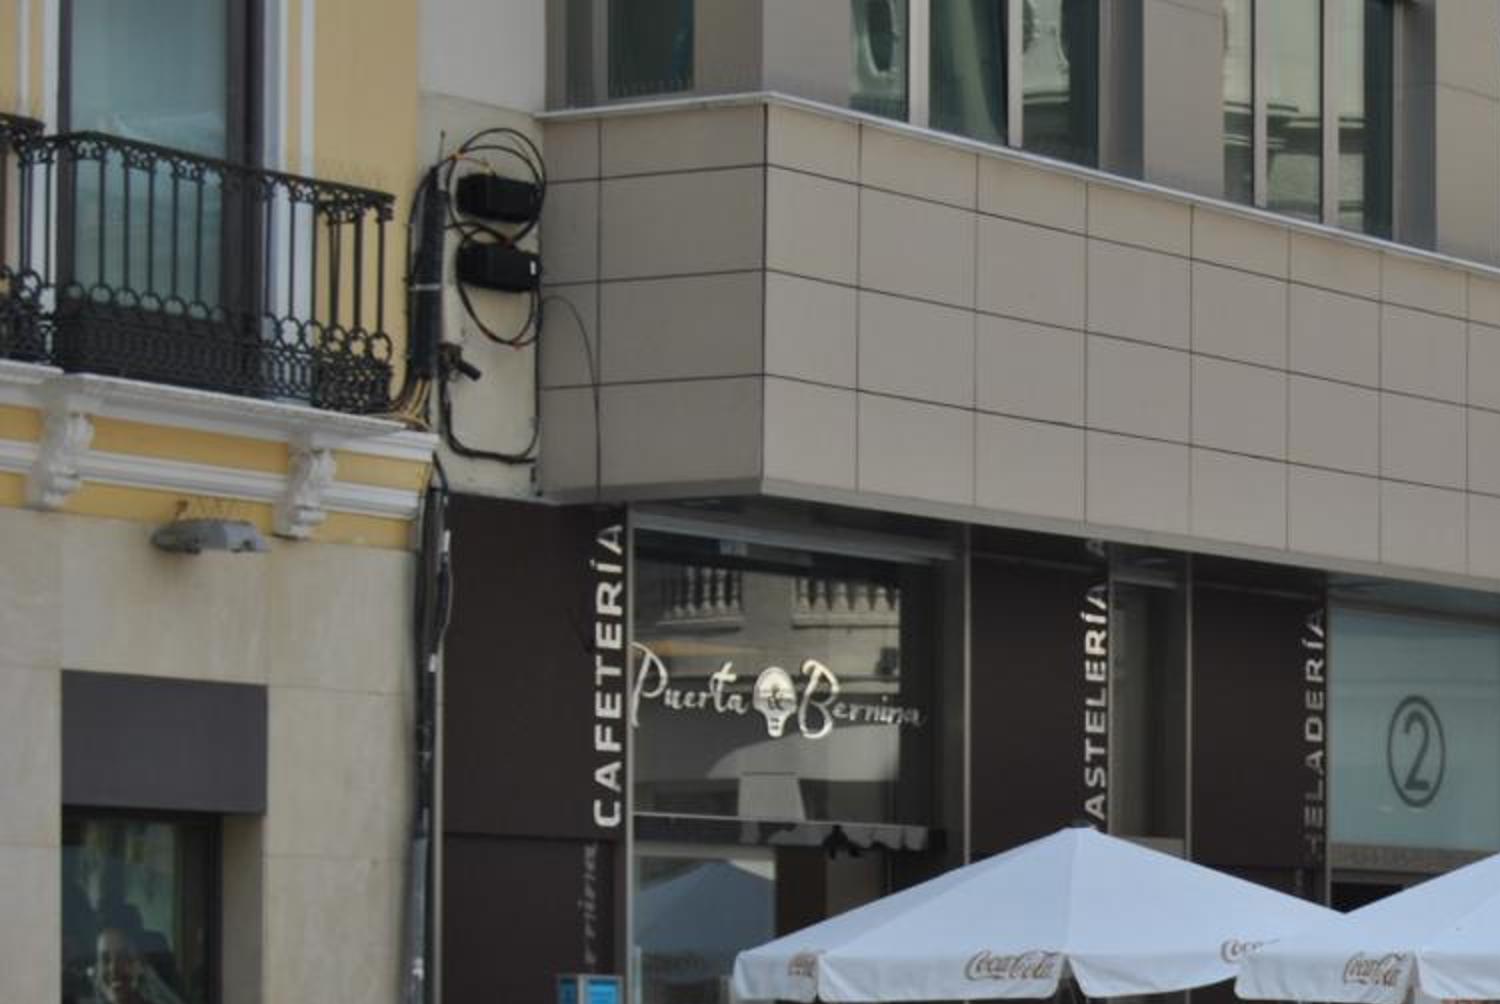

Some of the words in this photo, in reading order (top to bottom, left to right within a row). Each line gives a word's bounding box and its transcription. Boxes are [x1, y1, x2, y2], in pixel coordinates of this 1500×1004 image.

[590, 524, 624, 828] CAFETERÍA
[629, 641, 748, 728] Puerta
[798, 659, 925, 739] Bernina
[1081, 584, 1107, 822] ASTELERÍA
[1403, 710, 1430, 791] 2
